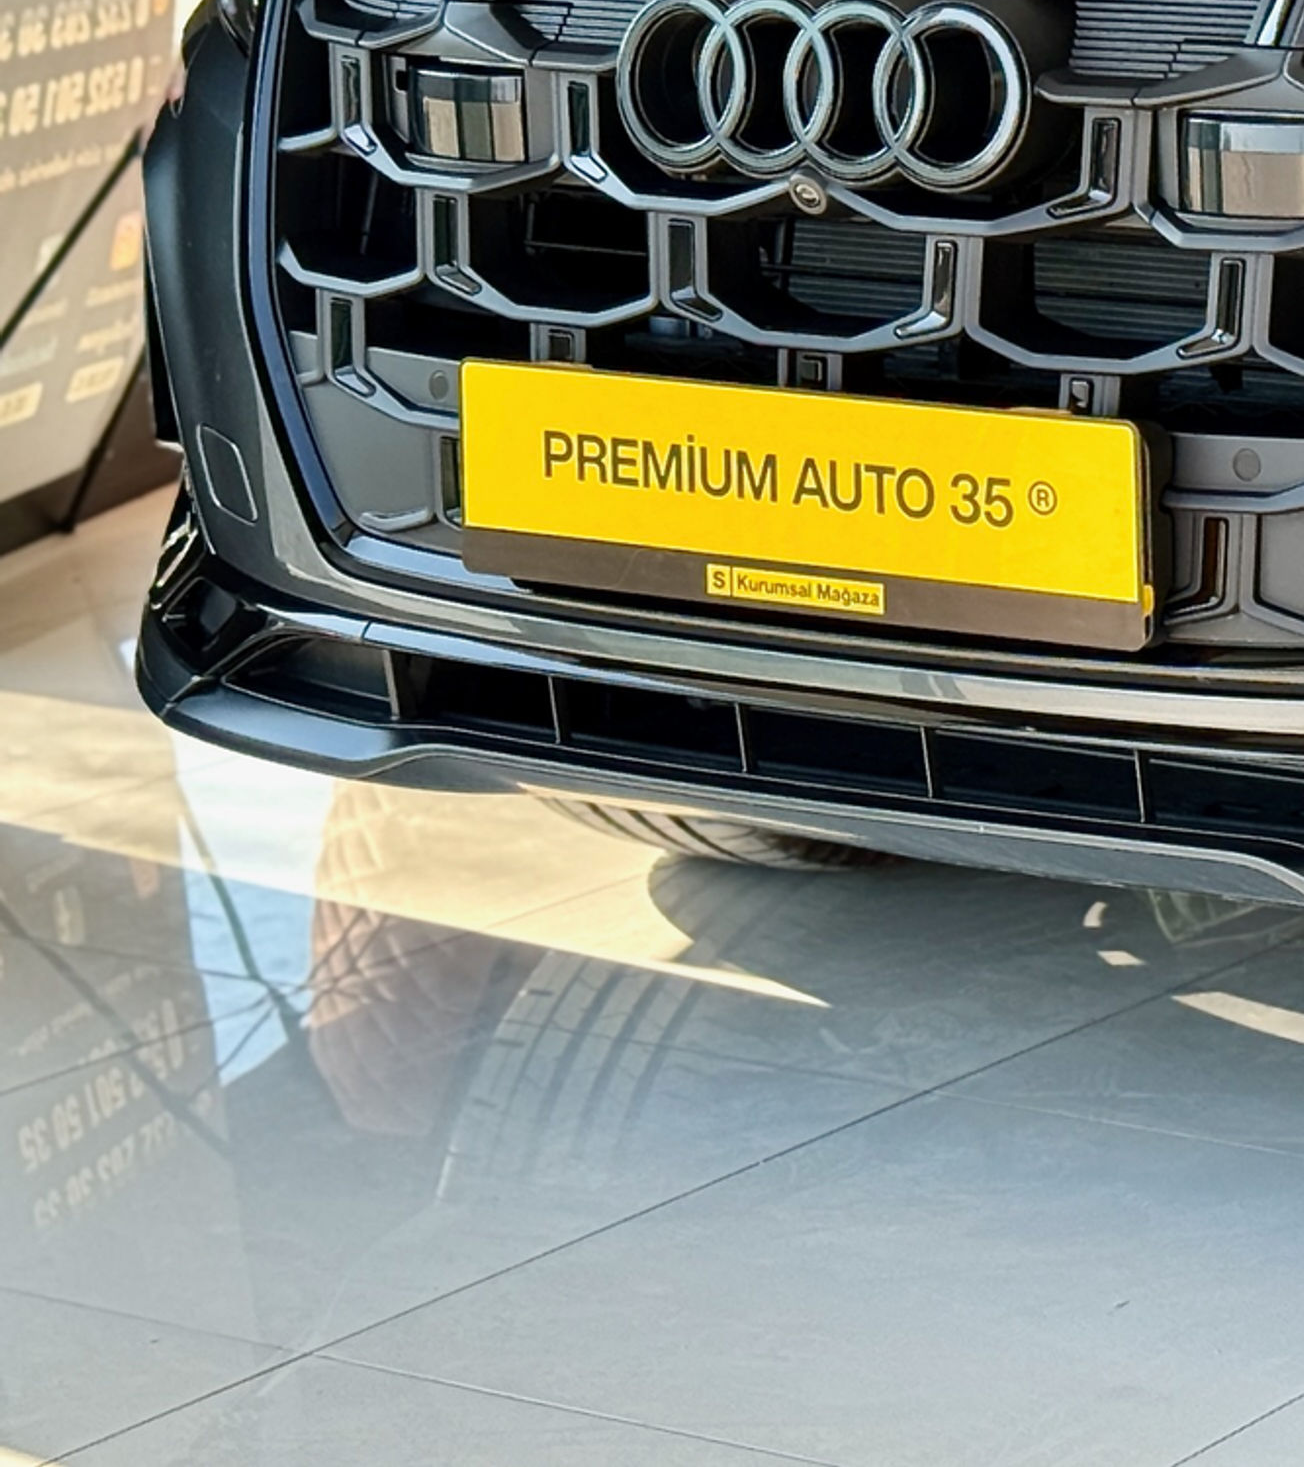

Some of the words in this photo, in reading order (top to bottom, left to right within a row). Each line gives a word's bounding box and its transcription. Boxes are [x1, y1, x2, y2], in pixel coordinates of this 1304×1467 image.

[793, 457, 935, 520] AUTO
[950, 472, 1014, 529] 35
[712, 570, 726, 590] S
[736, 574, 812, 599] Kurumsal
[817, 583, 880, 607] Mağaza
